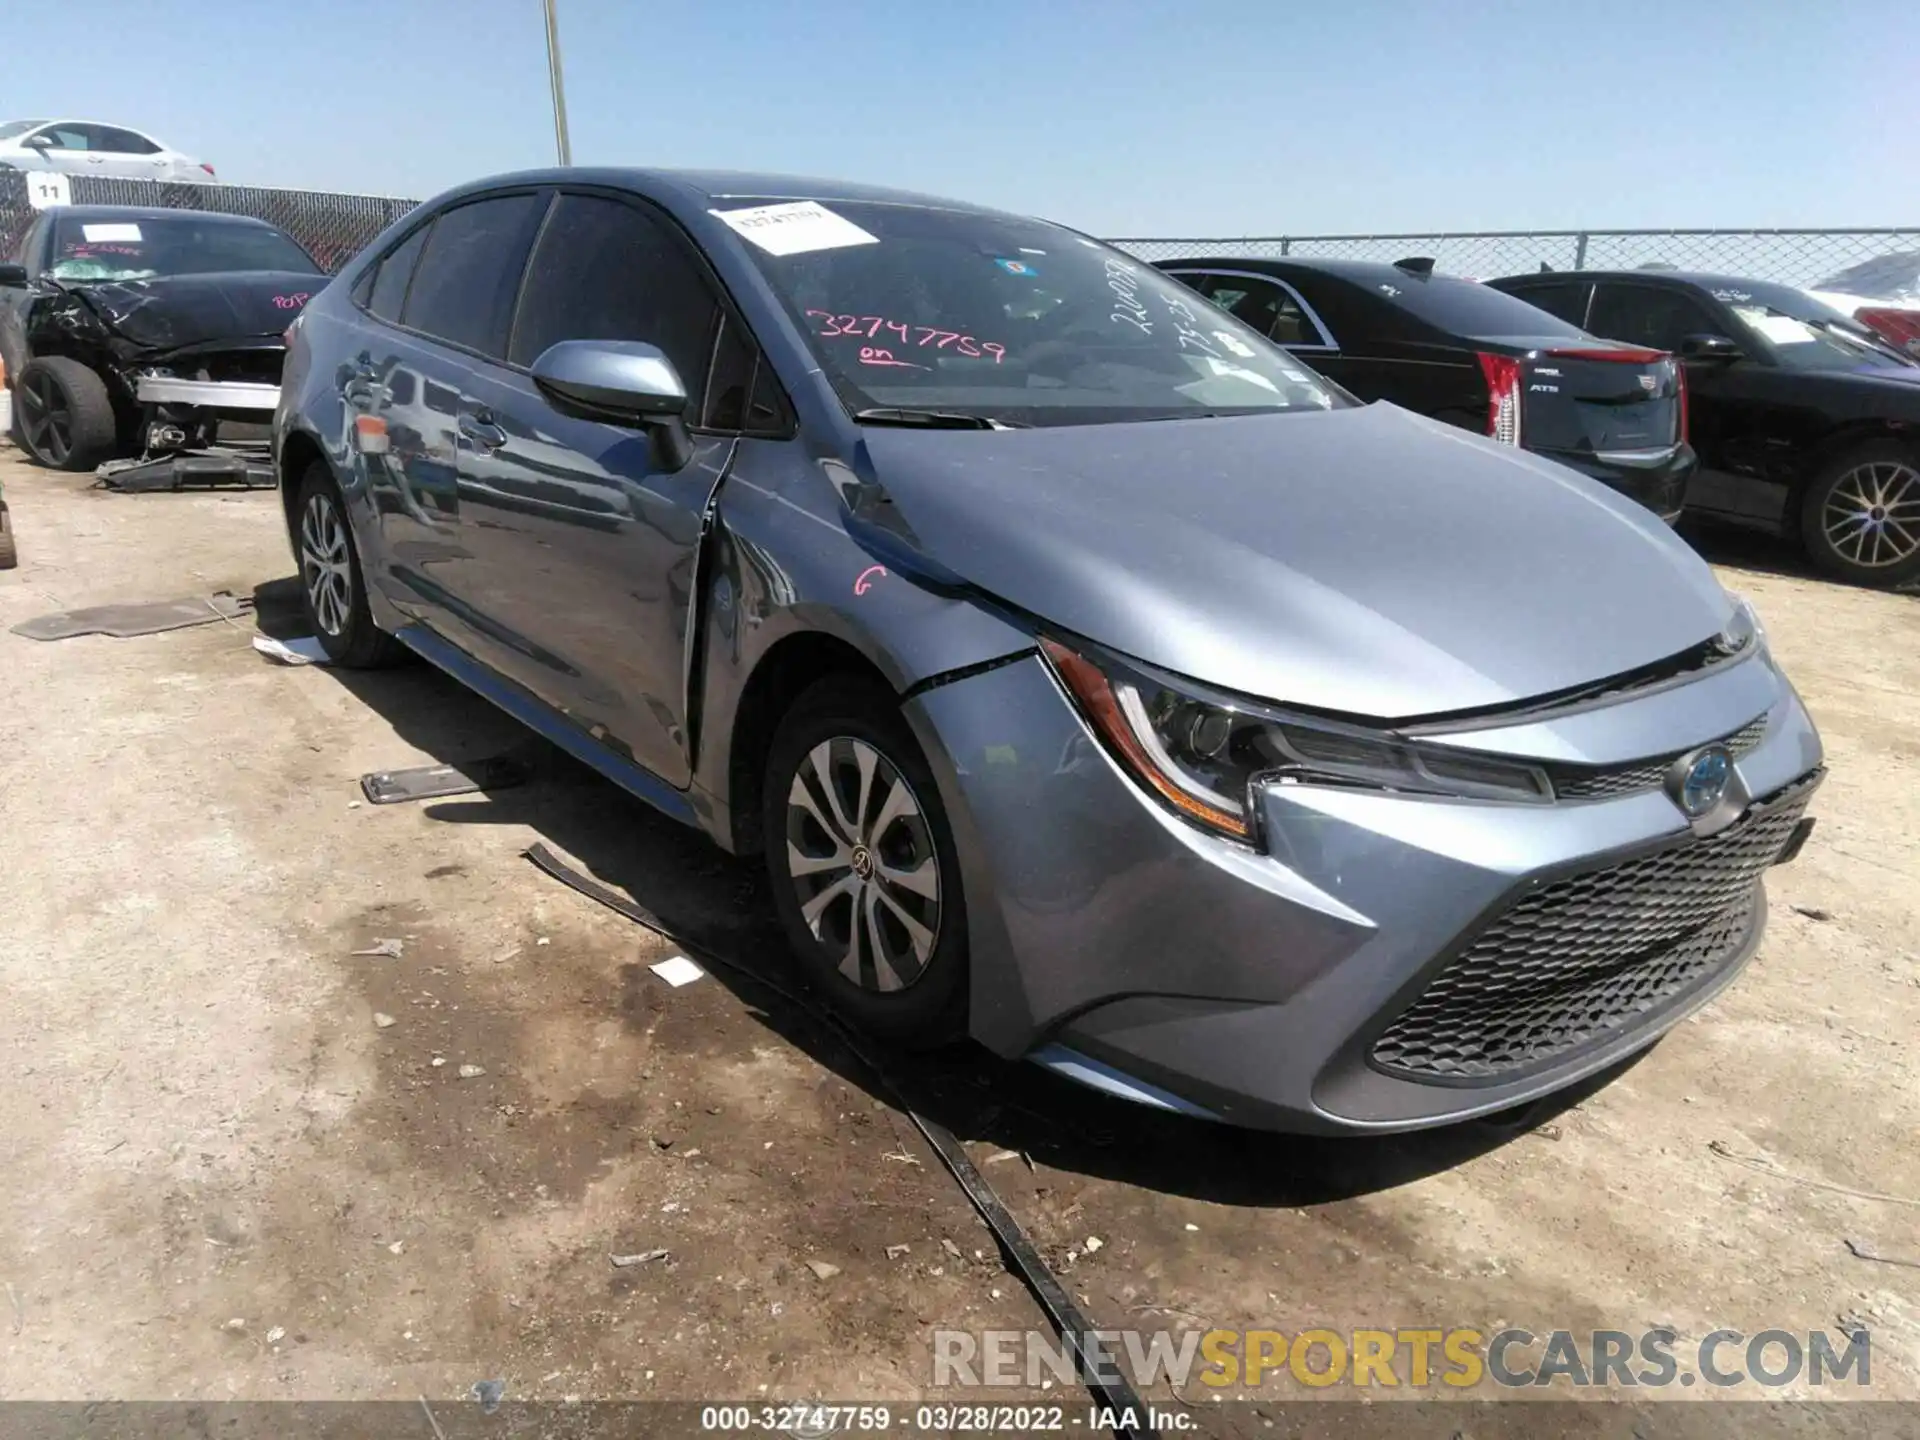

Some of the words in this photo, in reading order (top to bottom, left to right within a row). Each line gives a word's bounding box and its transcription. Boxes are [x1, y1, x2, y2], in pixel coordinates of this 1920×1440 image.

[39, 184, 59, 199] 11
[805, 309, 1006, 364] 32747759
[1530, 384, 1559, 393] ATS
